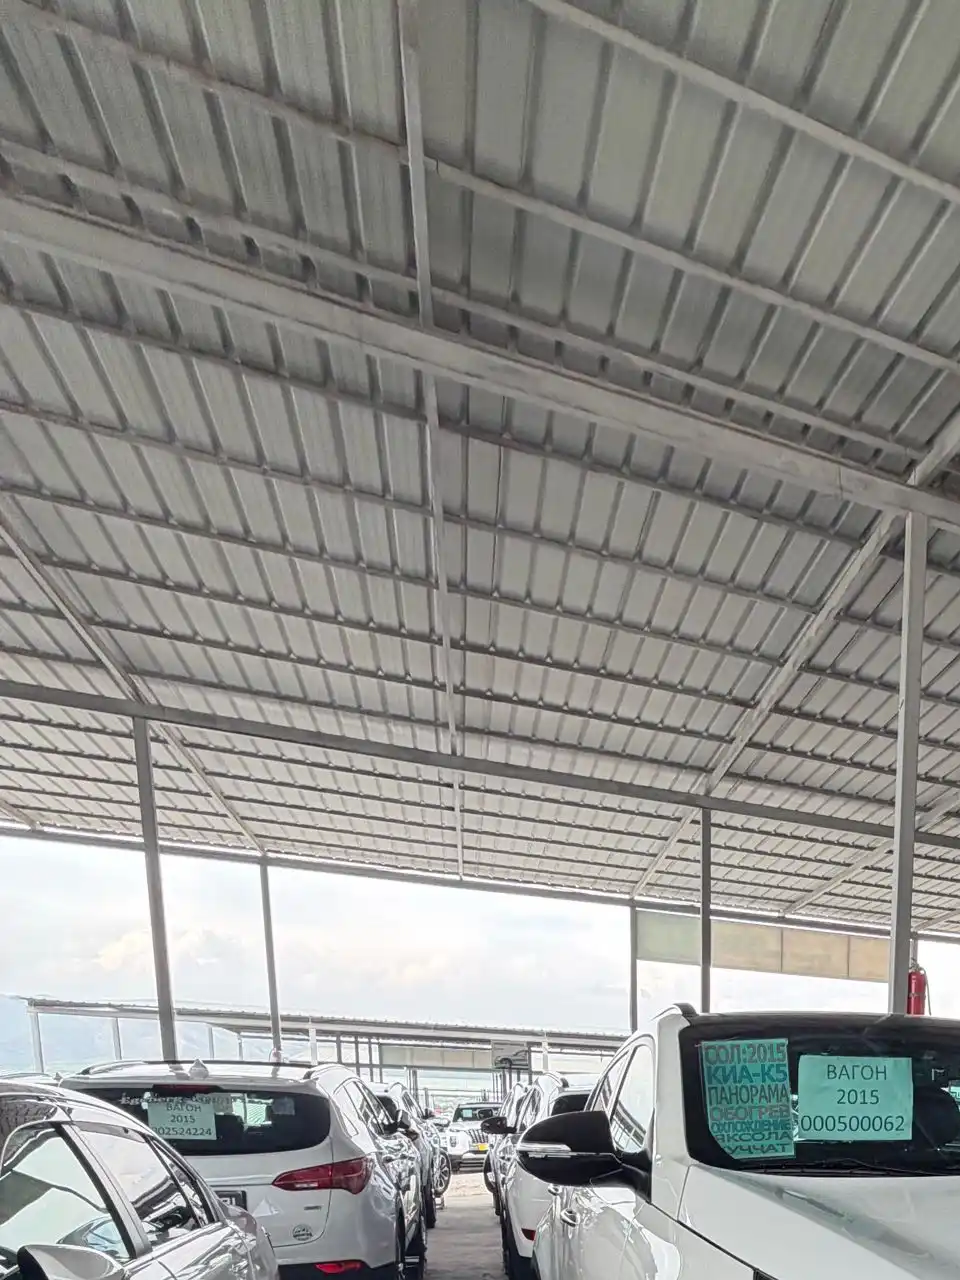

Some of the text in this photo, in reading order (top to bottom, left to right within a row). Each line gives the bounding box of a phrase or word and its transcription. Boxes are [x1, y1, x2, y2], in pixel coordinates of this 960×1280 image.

[706, 1064, 788, 1085] КИА-К5
[827, 1064, 888, 1080] ВАГОН
[708, 1083, 790, 1105] ПАНОРАМА
[836, 1089, 880, 1105] 2015
[170, 1114, 196, 1124] 2015
[800, 1115, 906, 1132] 000500062
